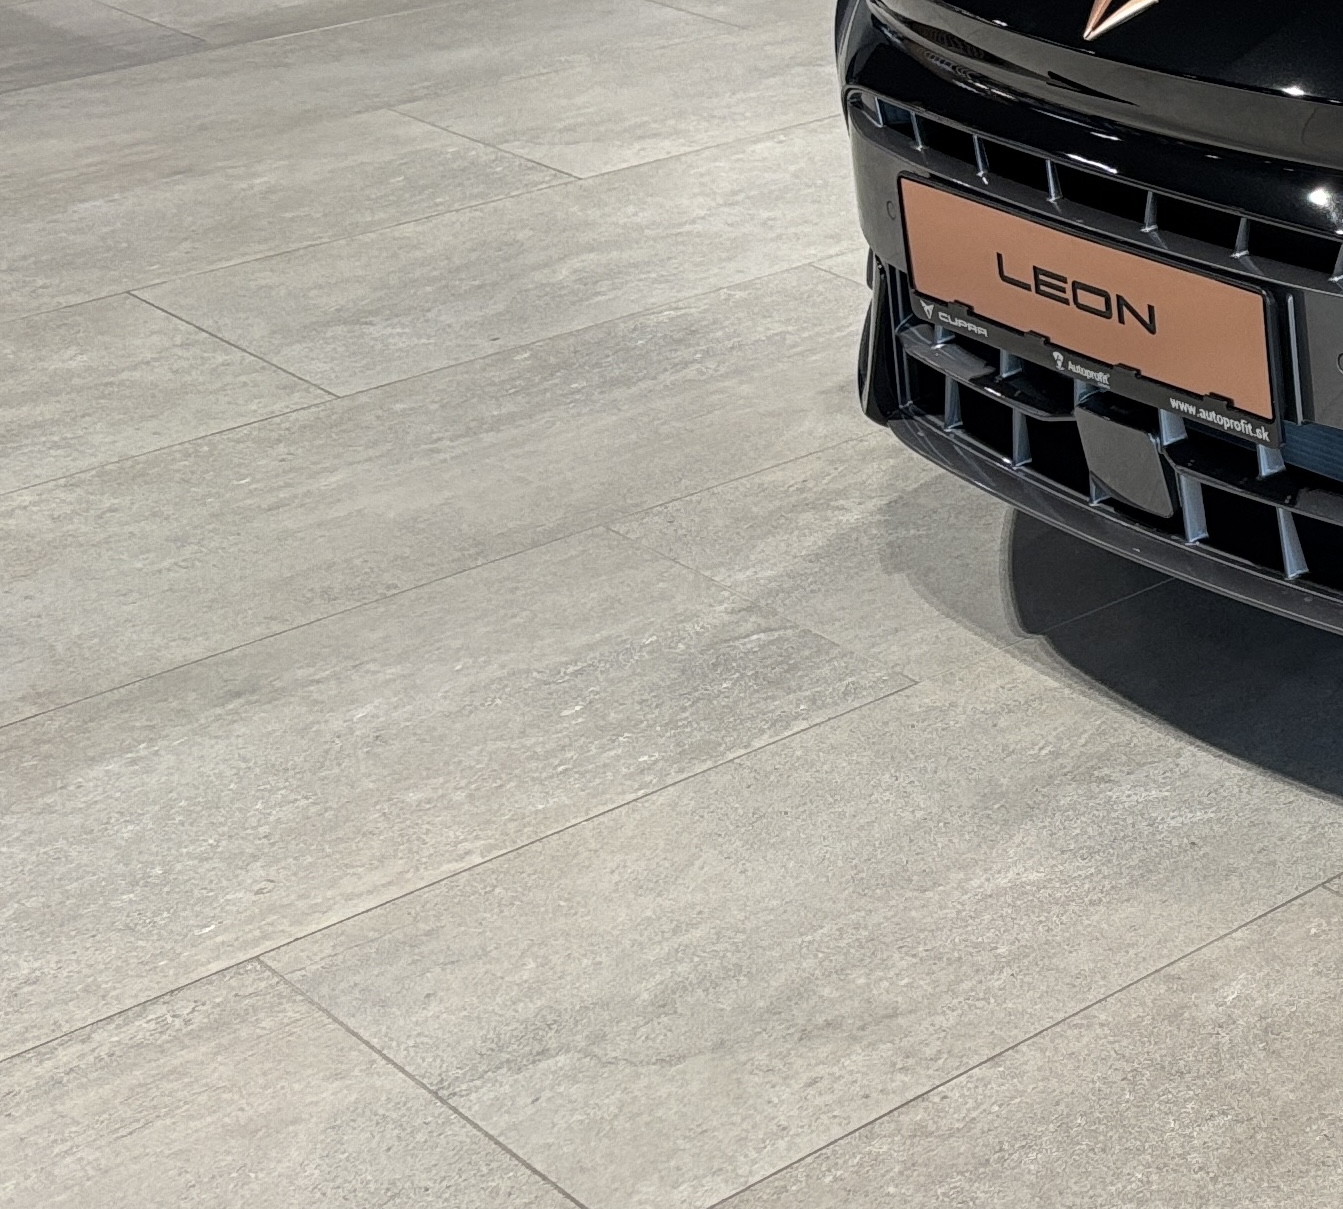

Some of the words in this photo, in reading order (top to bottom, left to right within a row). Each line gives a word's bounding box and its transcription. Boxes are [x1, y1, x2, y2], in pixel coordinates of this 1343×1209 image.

[996, 251, 1157, 336] LEON
[938, 310, 989, 338] CUPRA
[1067, 360, 1111, 385] Autoprofit
[1169, 397, 1271, 443] www.autoprofit.sk
